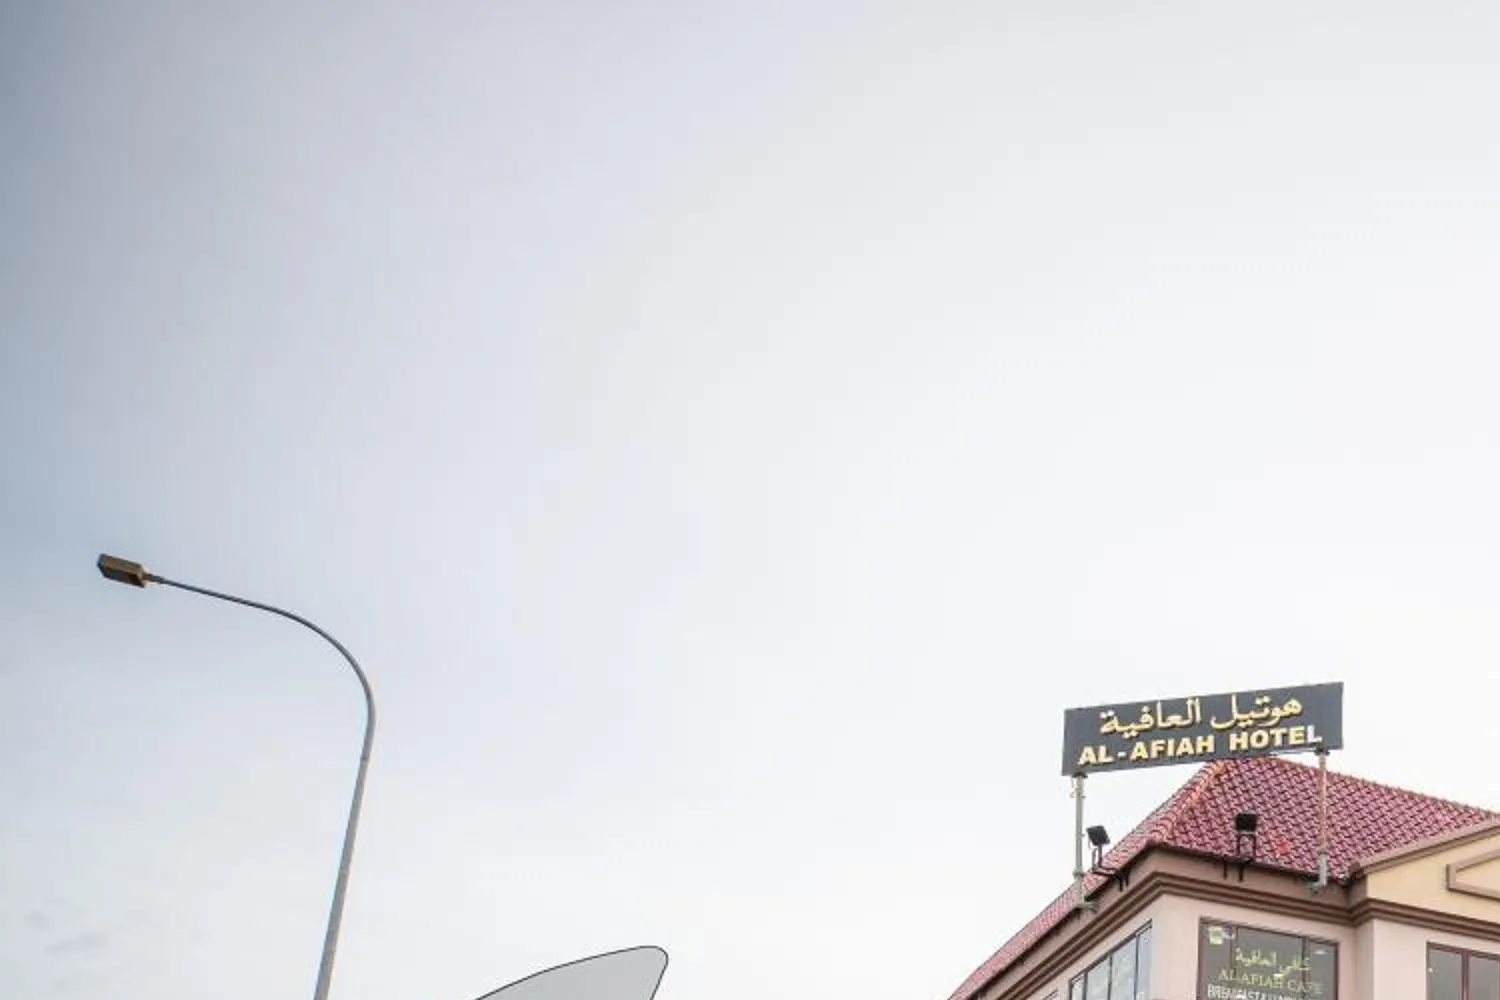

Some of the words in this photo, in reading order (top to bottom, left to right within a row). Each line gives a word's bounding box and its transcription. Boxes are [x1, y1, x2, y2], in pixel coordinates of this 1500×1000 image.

[1100, 698, 1202, 739] العافية
[1211, 694, 1303, 729] هوتيل
[1229, 725, 1323, 751] HOTEL
